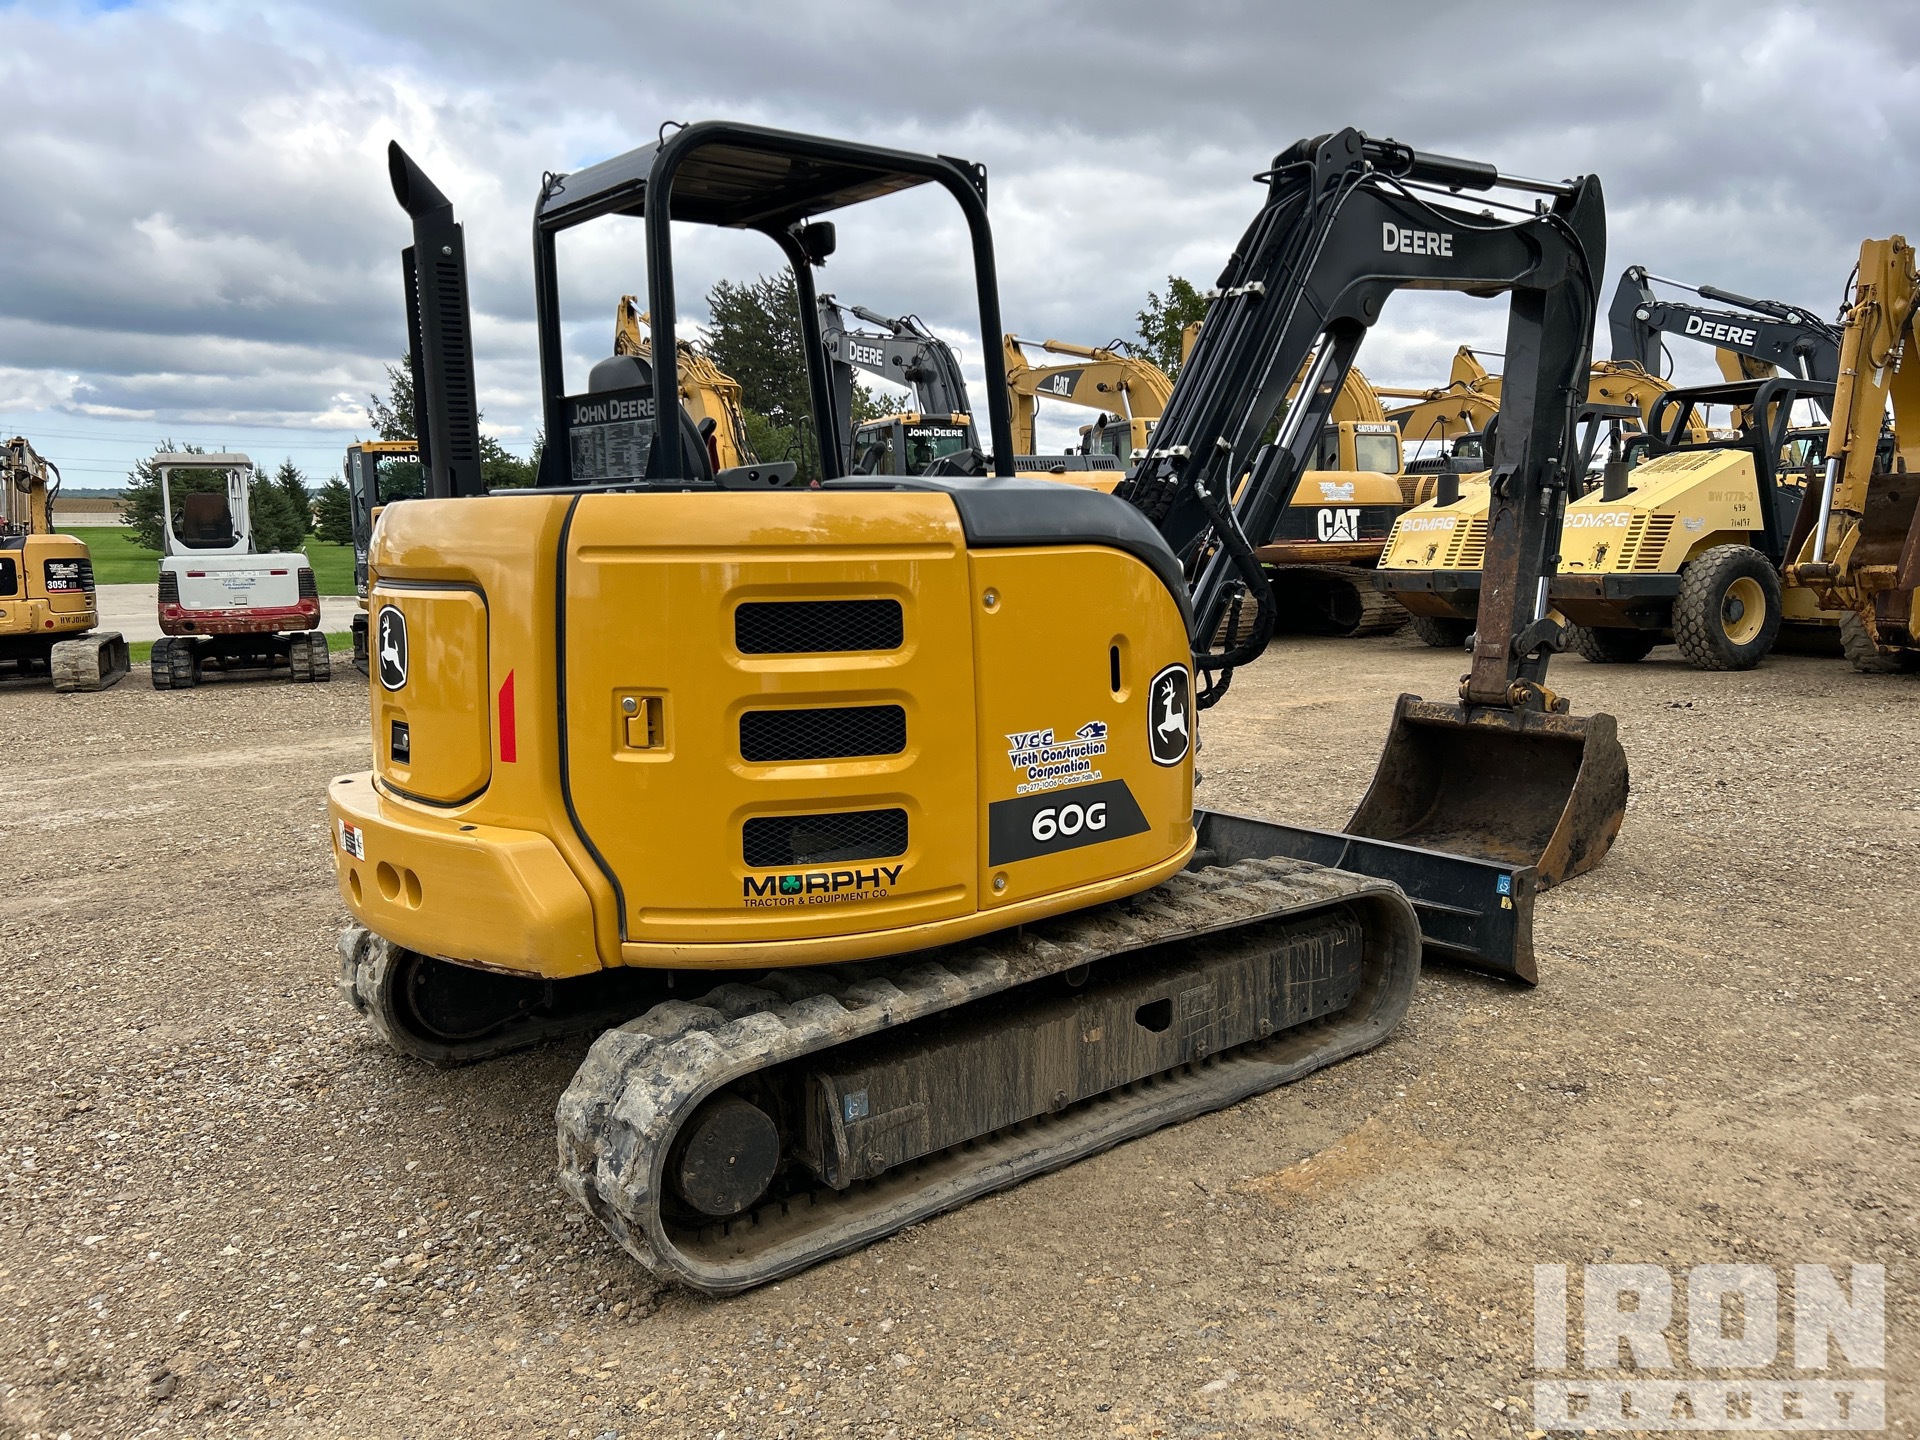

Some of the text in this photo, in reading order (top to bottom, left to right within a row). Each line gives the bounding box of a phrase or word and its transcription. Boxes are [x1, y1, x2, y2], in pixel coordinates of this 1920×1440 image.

[1382, 222, 1453, 257] DEERE
[1684, 315, 1757, 346] DEERE
[849, 340, 883, 367] DEERE
[1053, 375, 1070, 396] CAT
[572, 398, 656, 424] JOHN DEERE
[908, 428, 963, 437] JOHN DEERE
[1357, 424, 1391, 433] CATERPILLAR
[381, 454, 408, 463] JOHN
[1317, 508, 1361, 542] CAT
[1401, 516, 1456, 532] BOMAG
[1563, 512, 1630, 528] BOMAG
[47, 580, 67, 589] 305C
[1008, 730, 1053, 751] VCC
[1011, 743, 1105, 767] Vieth Construction
[1028, 760, 1090, 780] Corporation
[1017, 780, 1058, 793] 319-277-1006
[1063, 776, 1080, 784] Cedar
[1031, 802, 1107, 841] 60G
[743, 864, 904, 897] MURPHY
[743, 888, 889, 908] TRACTOR & EQUIPMENT CO.
